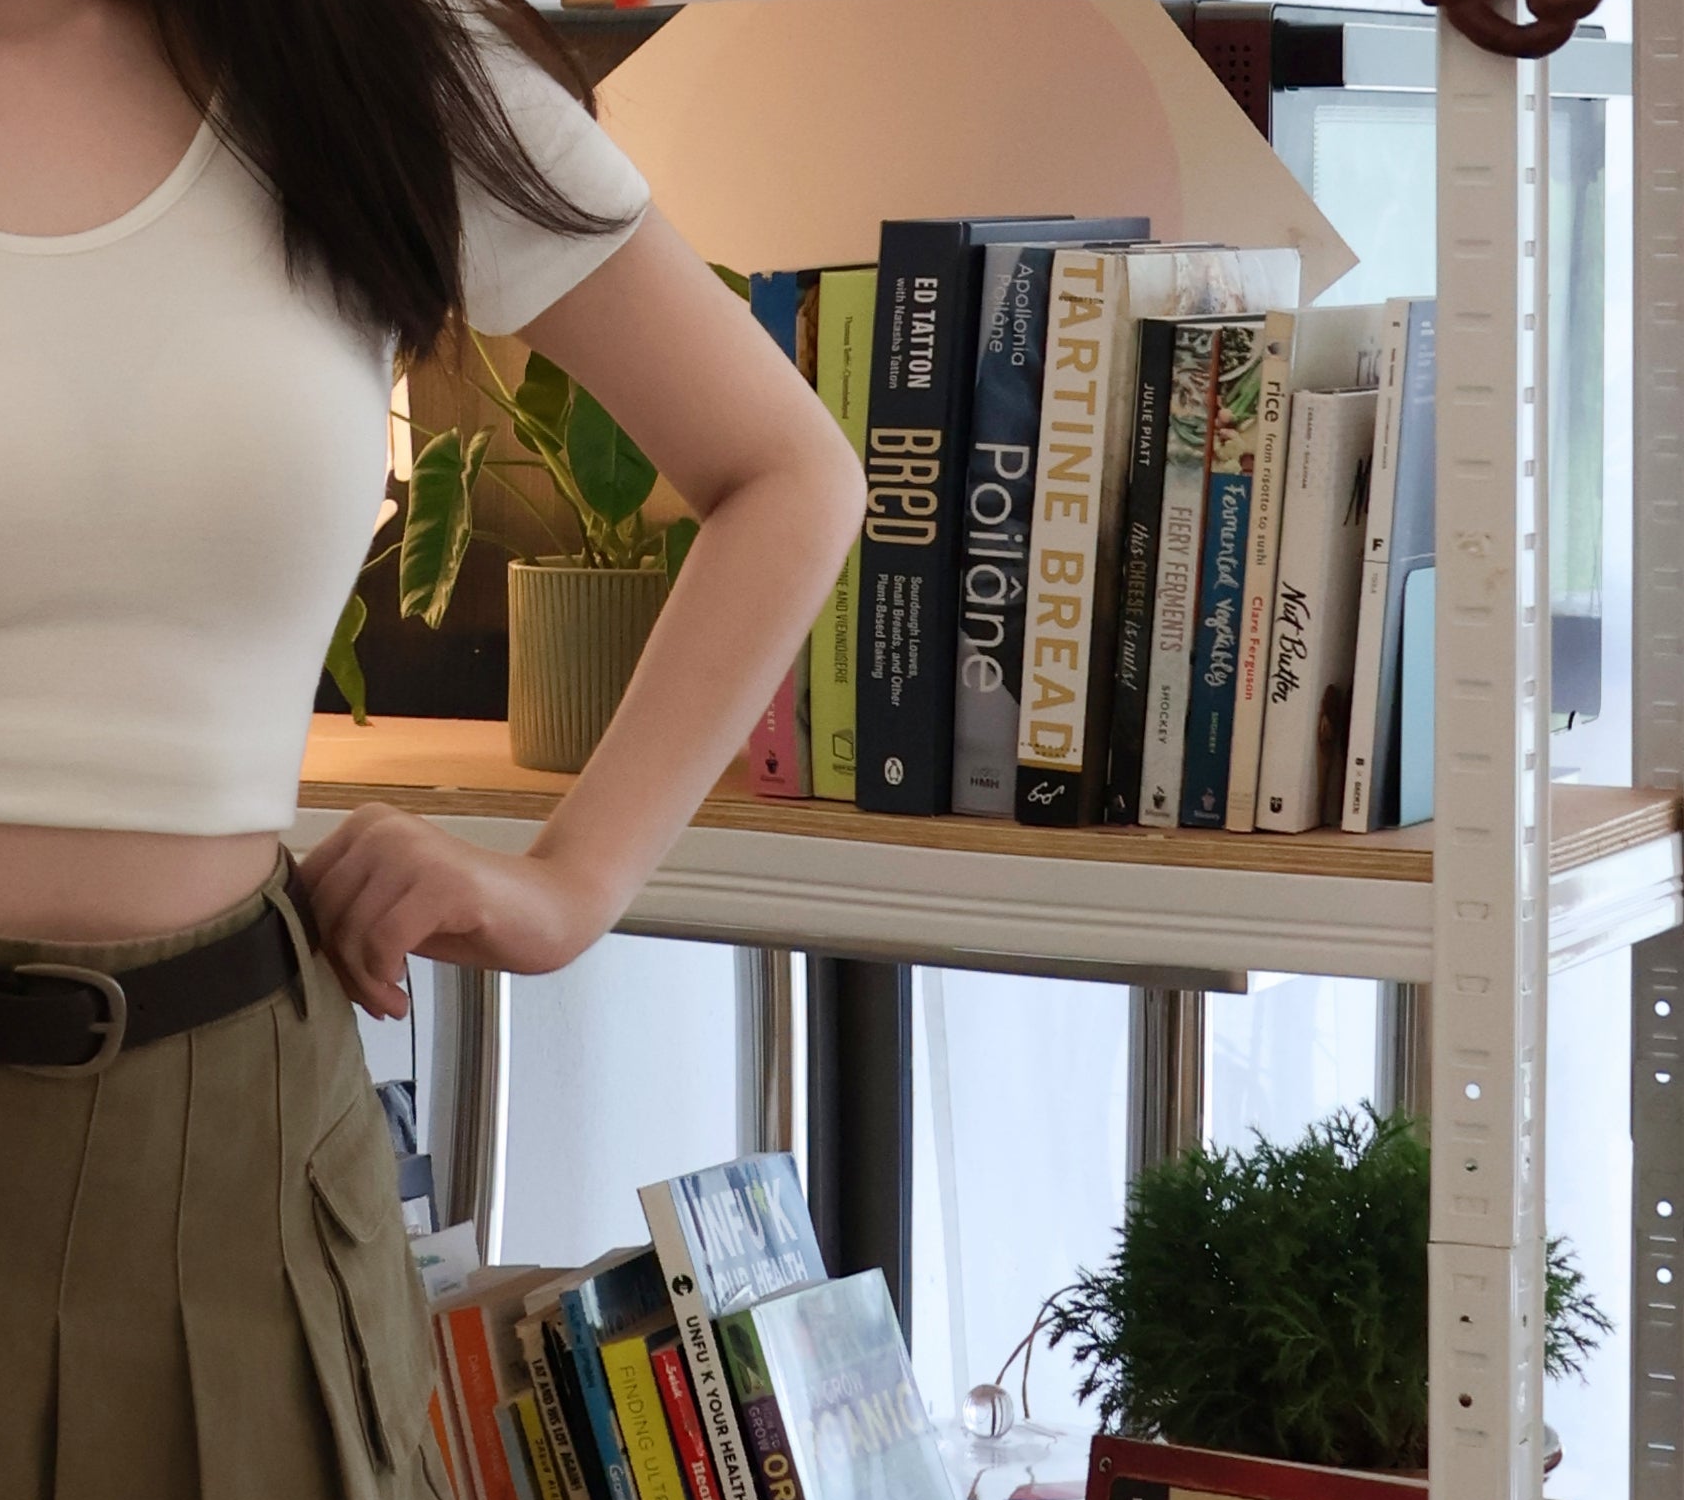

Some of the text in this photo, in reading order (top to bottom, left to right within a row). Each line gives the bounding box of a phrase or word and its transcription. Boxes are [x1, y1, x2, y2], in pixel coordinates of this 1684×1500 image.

[888, 277, 907, 389] with Natasha Tatton
[907, 277, 938, 389] ED TATTON
[989, 274, 1012, 353] Poilâne
[1011, 263, 1034, 366] Apollonia
[1044, 257, 1105, 524] TARTINE
[1139, 382, 1155, 467] JULIE PIATT
[1256, 380, 1285, 566] rice from risotto to sushi
[961, 443, 1030, 694] Poilâne
[1126, 561, 1148, 617] CHEESE
[1159, 505, 1193, 653] FIERY FERMENTS
[1214, 484, 1246, 589] Fermented
[871, 573, 889, 679] Plant-Based Baking
[891, 574, 906, 707] Small Breads, and Other
[907, 576, 923, 679] Sourdough Loaves,
[1029, 548, 1085, 758] BREAD
[1244, 596, 1264, 701] Clare Ferguson
[1272, 581, 1311, 704] Nut Butter
[1158, 685, 1171, 744] SHOCKEY
[970, 776, 1000, 789] HMH
[750, 1250, 809, 1297] HEALTH
[619, 1364, 655, 1452] FINDING
[705, 1386, 731, 1432] YOUR
[747, 1405, 771, 1451] GROW
